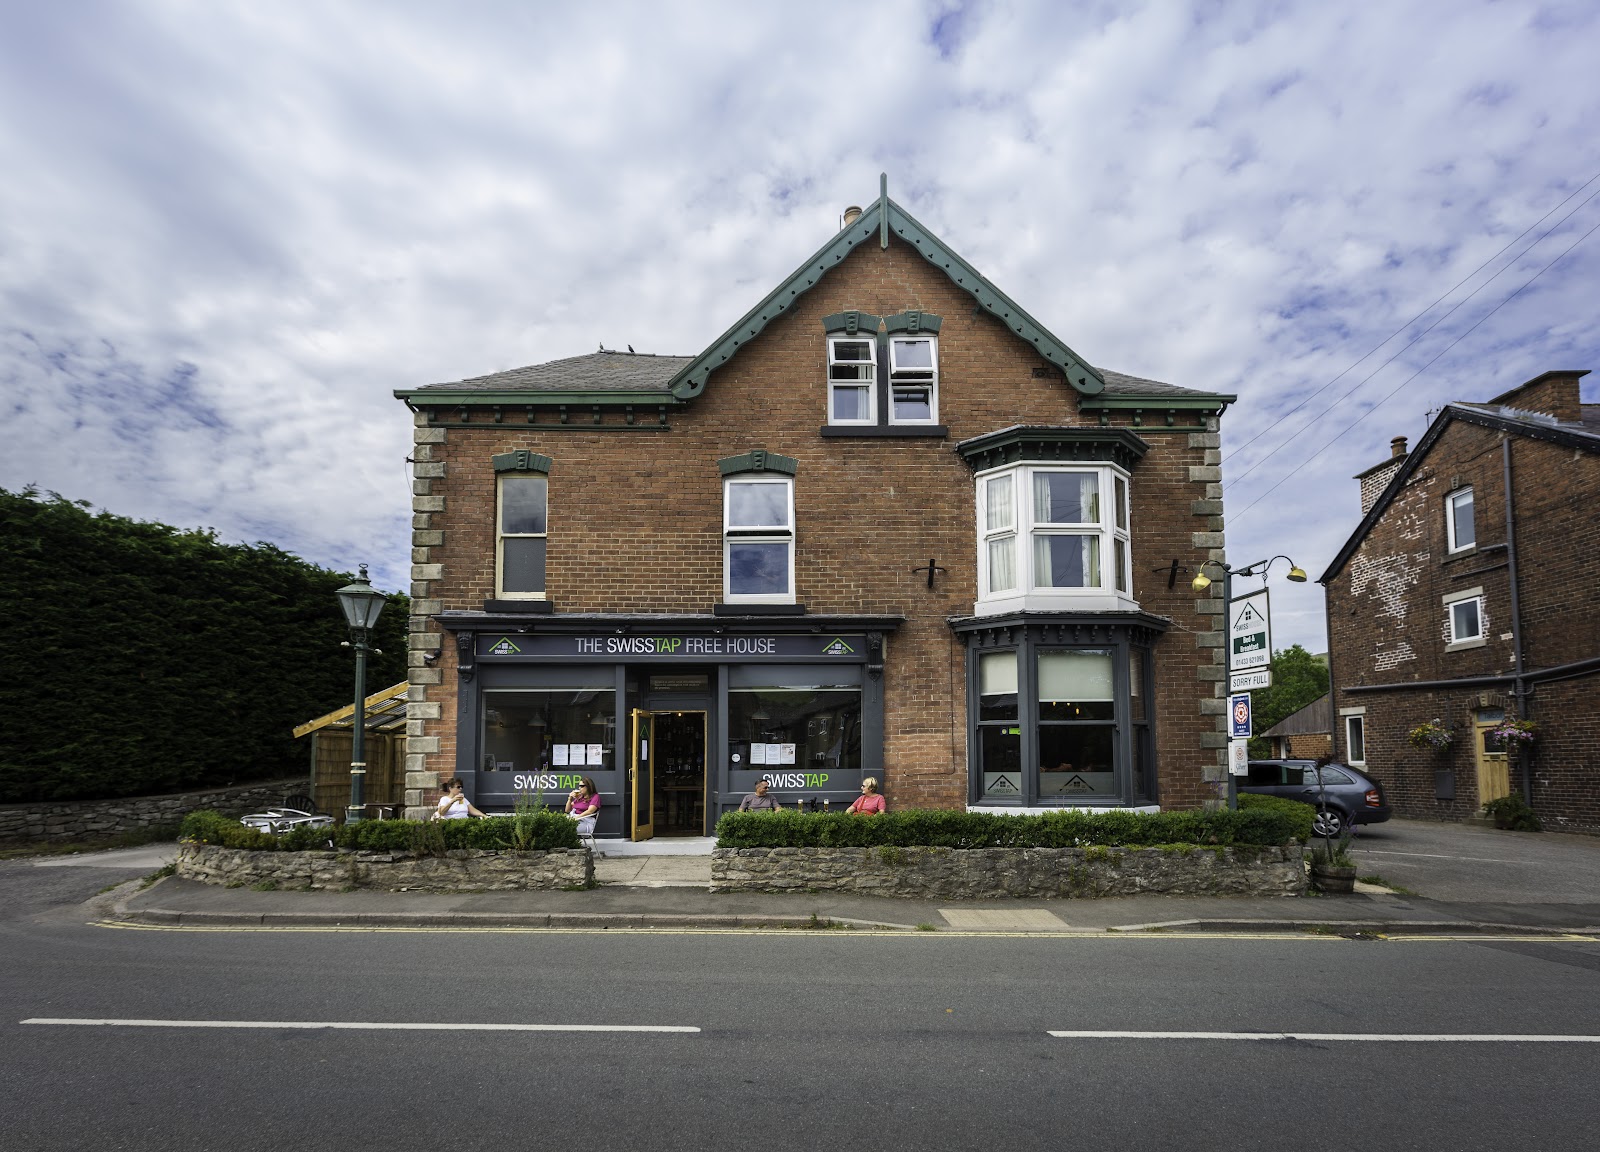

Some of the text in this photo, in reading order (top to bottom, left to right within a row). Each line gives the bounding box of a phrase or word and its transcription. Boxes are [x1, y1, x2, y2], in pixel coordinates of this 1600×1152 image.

[574, 637, 776, 653] THE SWISSTAP FREE HOUSE
[1243, 635, 1251, 644] Bed
[1240, 642, 1259, 652] Breakfast
[1232, 674, 1268, 688] SORRY FULL
[513, 774, 582, 789] SWISSTAP
[763, 773, 829, 788] SWISSTAP
